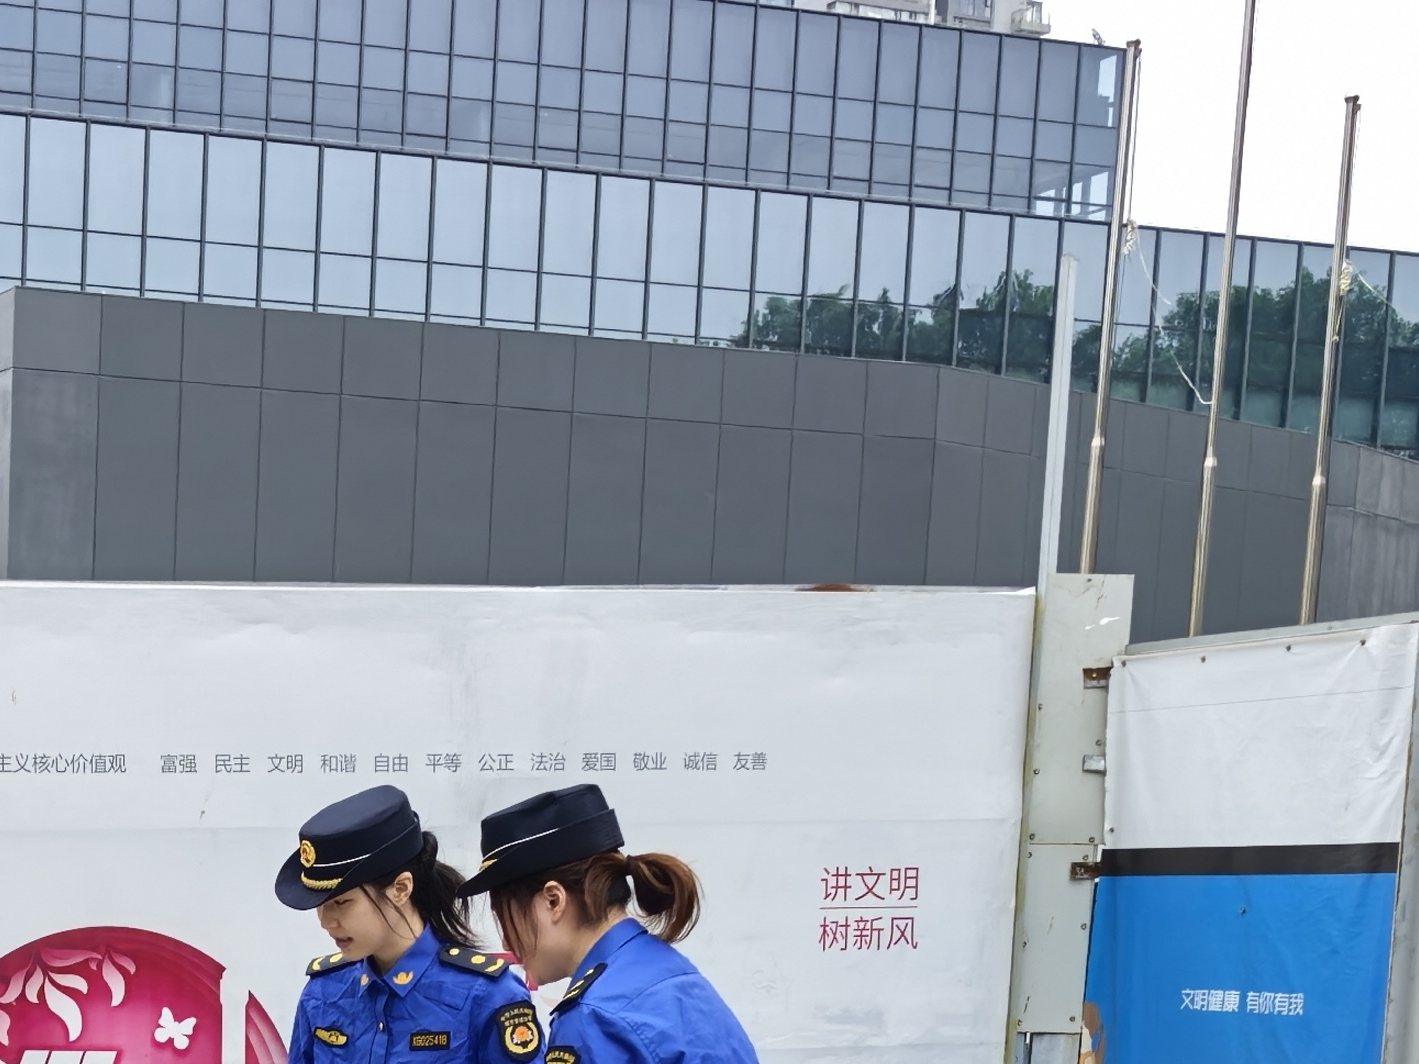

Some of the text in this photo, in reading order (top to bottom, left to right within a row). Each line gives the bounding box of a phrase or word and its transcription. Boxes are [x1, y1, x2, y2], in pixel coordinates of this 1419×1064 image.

[160, 752, 198, 775] 富强
[214, 752, 251, 775] 民主
[267, 752, 304, 775] 文明
[320, 752, 357, 775] 和谐
[374, 752, 409, 773] 自由
[425, 752, 463, 773] 平等
[477, 752, 515, 773] 公正
[530, 752, 566, 773] 法治
[580, 752, 617, 773] 爱国
[632, 752, 668, 773] 敬业
[683, 752, 718, 773] 诚信
[732, 752, 768, 773] 友善
[820, 866, 919, 902] 讲文明
[818, 916, 919, 952] 树新风
[1180, 988, 1305, 1016] 文明健康 有你有我
